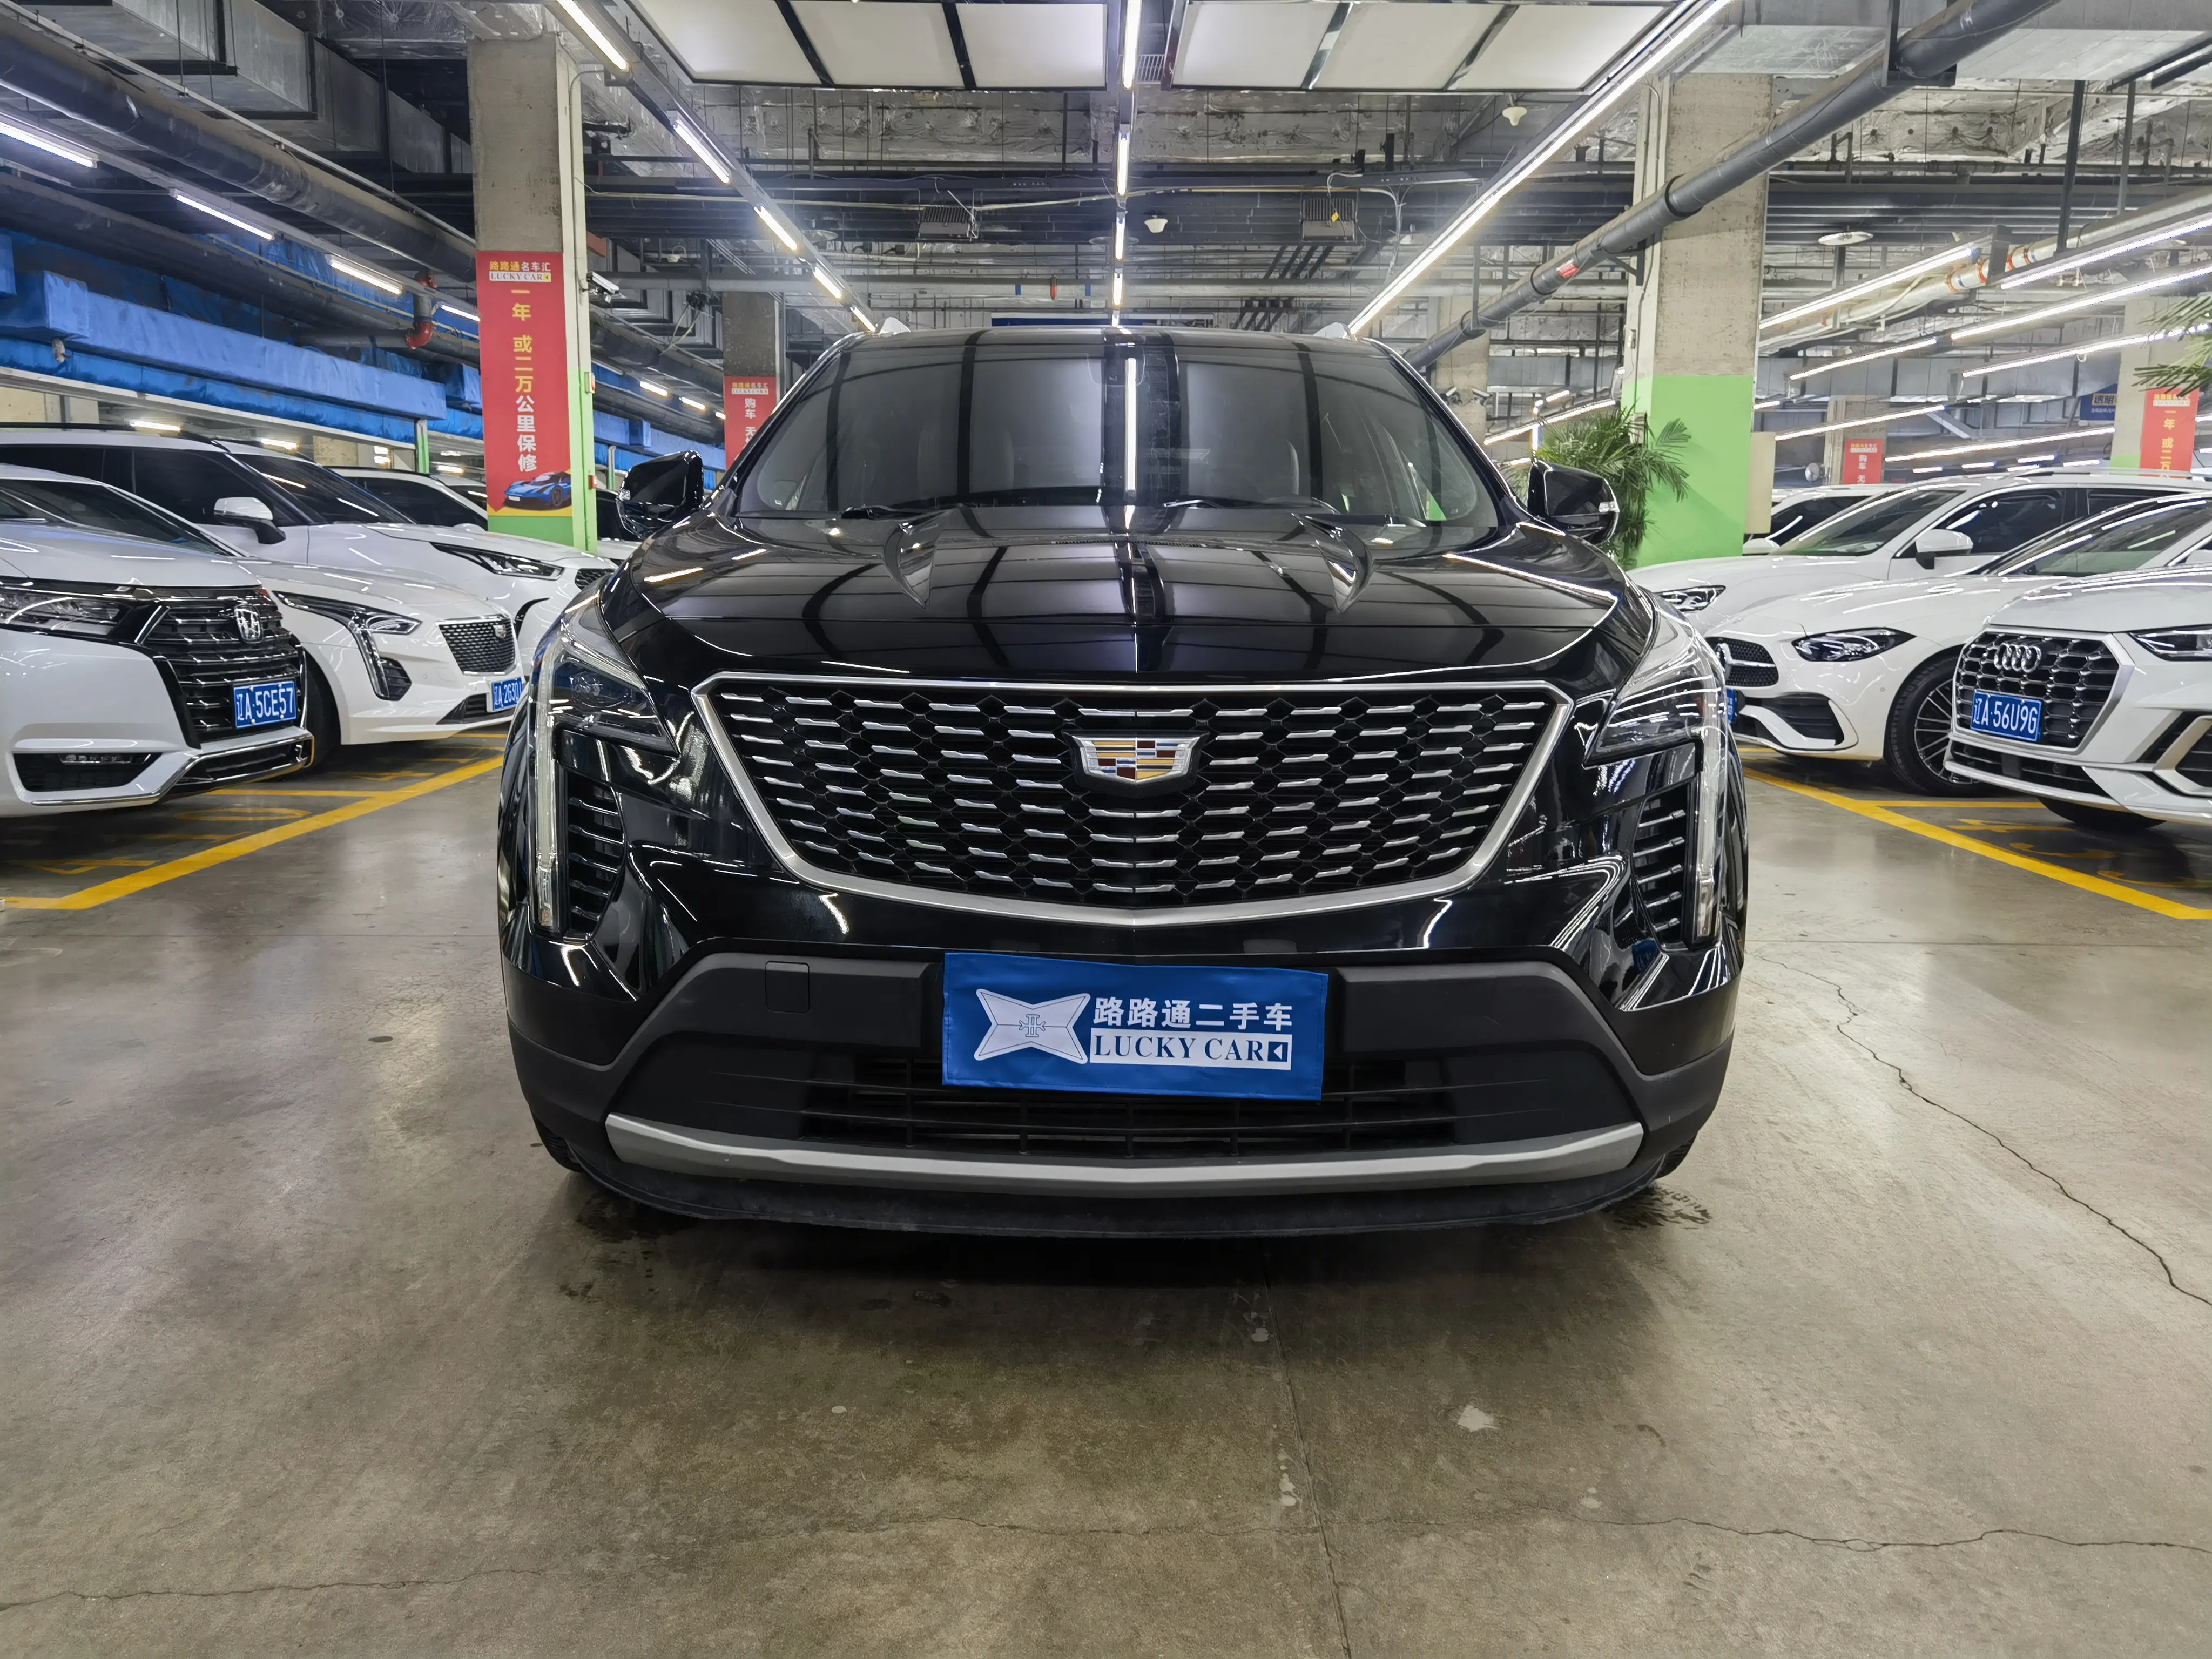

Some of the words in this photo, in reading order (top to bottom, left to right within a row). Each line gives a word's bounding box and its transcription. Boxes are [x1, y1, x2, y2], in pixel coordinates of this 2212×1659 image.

[491, 272, 522, 280] LUCKY
[745, 397, 757, 419] 购车
[236, 687, 294, 721] 辽A·5CE57
[1972, 697, 2038, 734] 辽A·56U9G
[1093, 996, 1292, 1031] 路路通二手车
[1094, 1034, 1197, 1060] LUCKY
[1205, 1038, 1264, 1062] CAR
